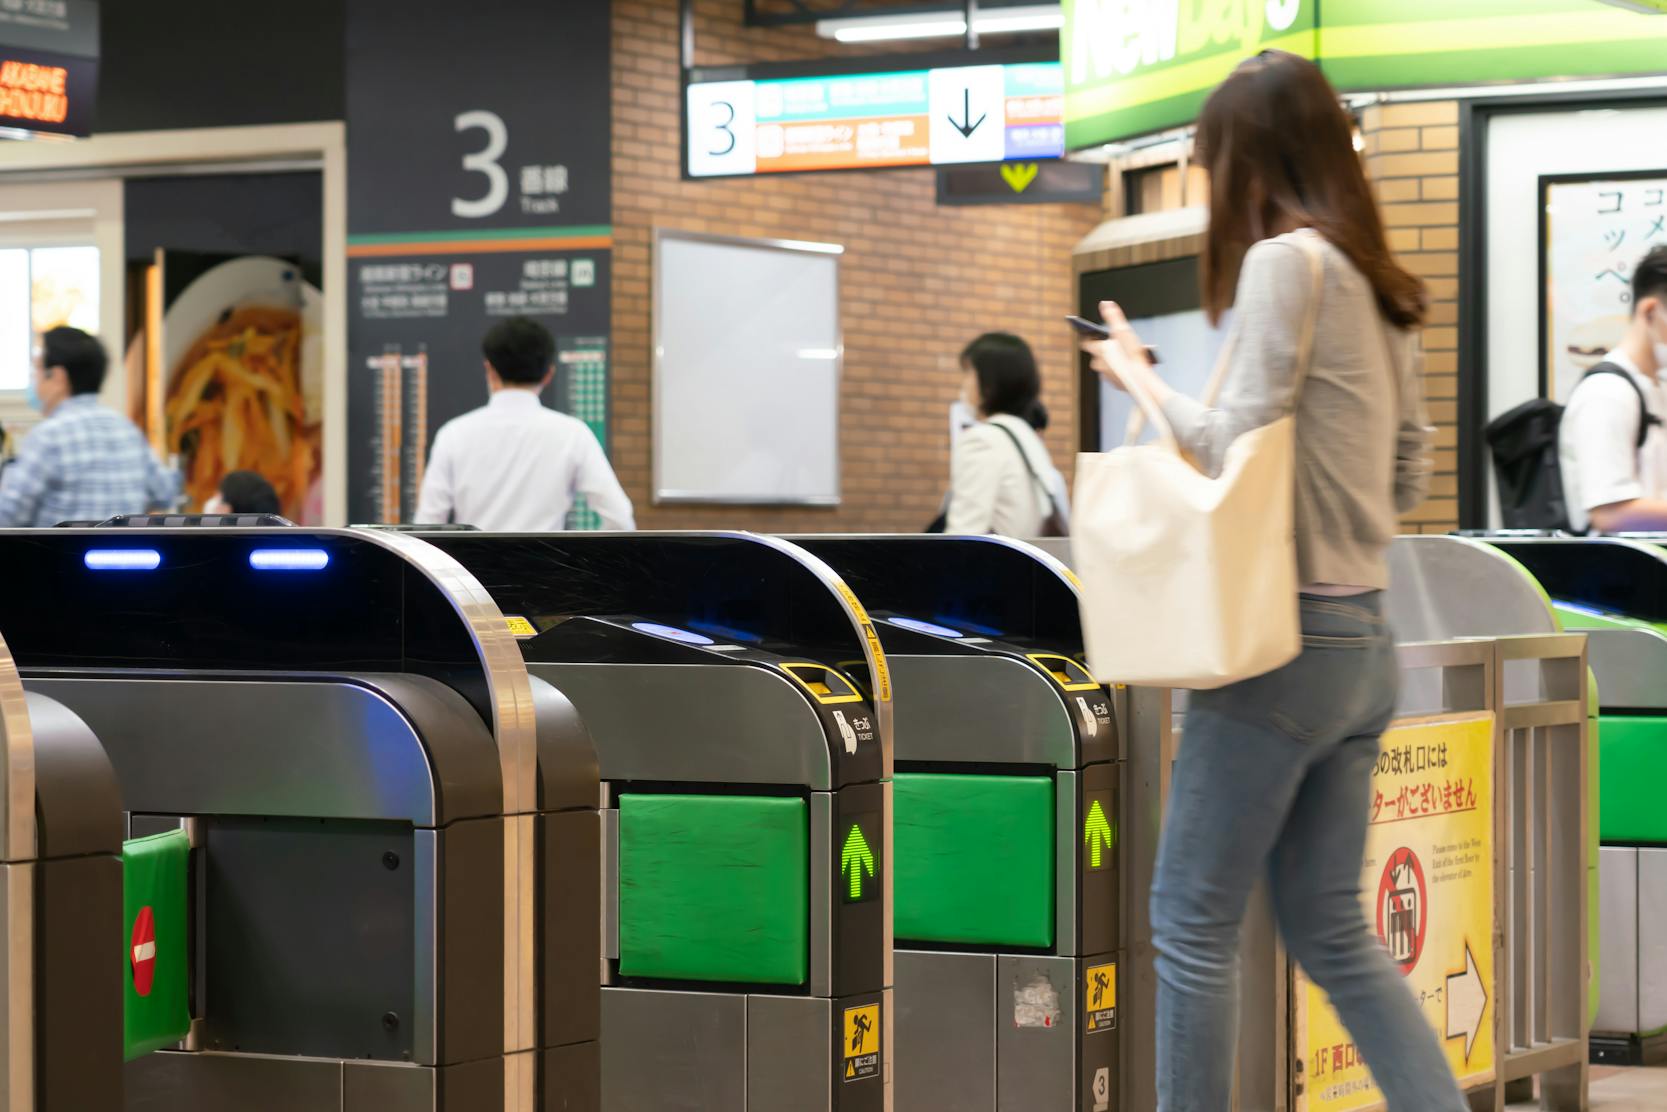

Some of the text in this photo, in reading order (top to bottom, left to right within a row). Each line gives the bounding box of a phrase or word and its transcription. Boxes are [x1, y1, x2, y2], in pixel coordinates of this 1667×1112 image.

[708, 100, 736, 156] 3
[451, 109, 509, 219] 3
[1369, 777, 1477, 822] ターがございません
[1415, 987, 1442, 1008] ターで
[1098, 1075, 1105, 1096] 3
